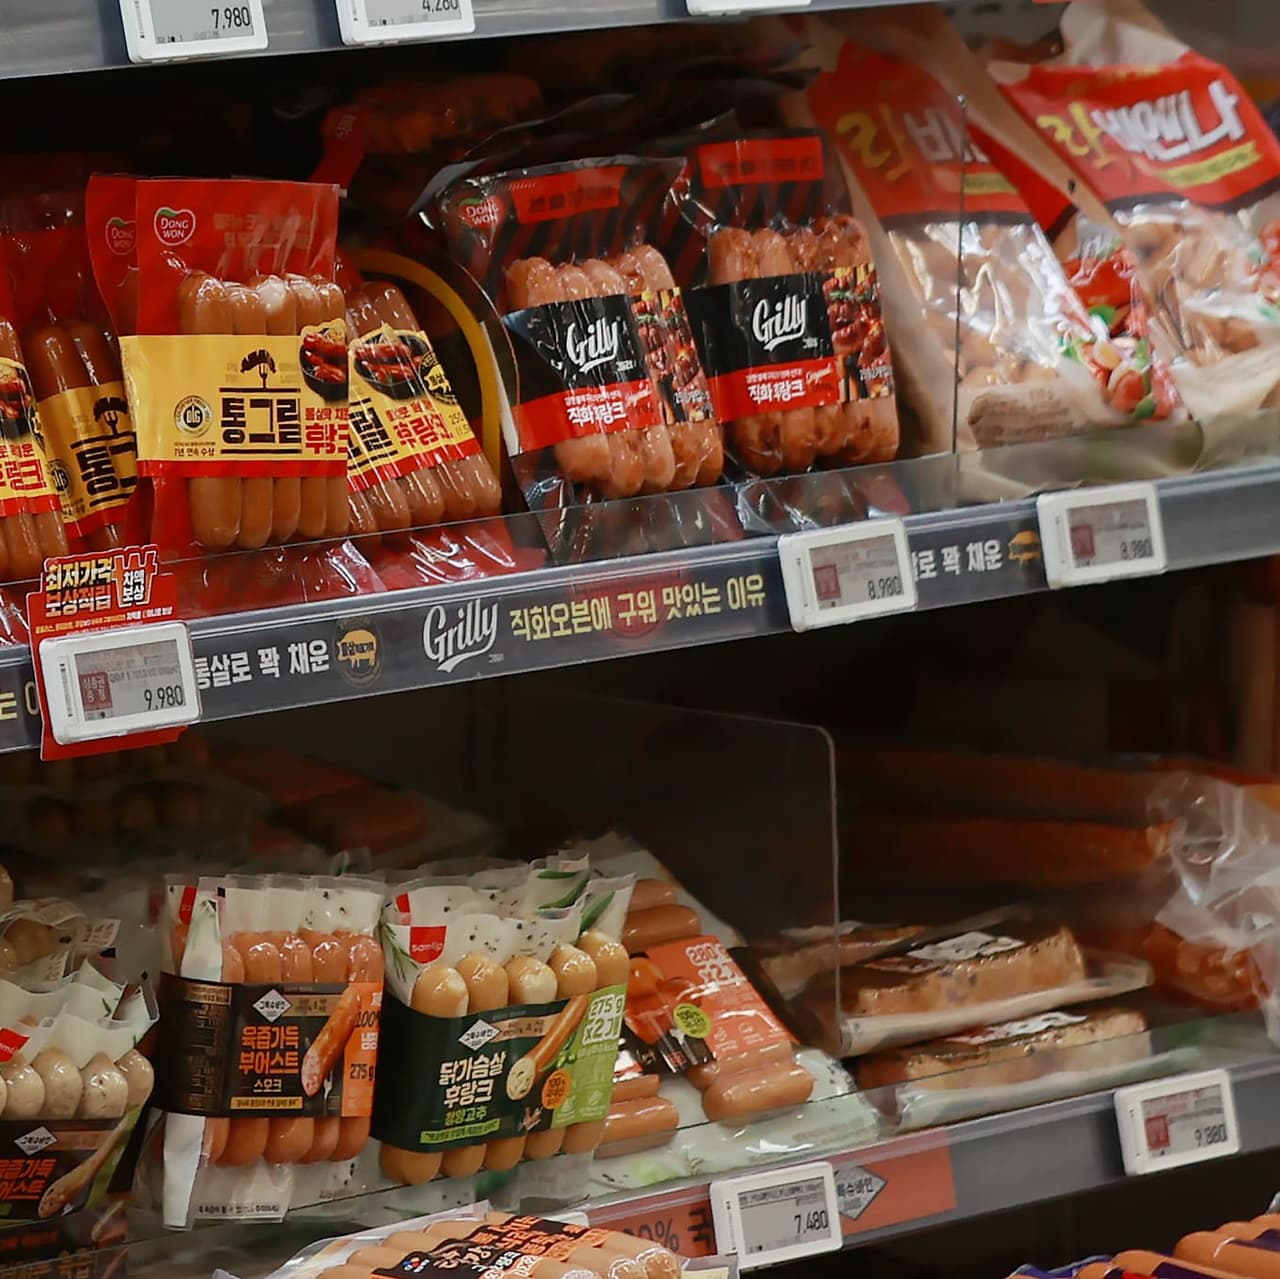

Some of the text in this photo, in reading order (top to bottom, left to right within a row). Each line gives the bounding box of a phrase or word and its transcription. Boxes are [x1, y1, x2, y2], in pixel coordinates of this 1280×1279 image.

[160, 216, 190, 230] DONG
[162, 228, 185, 240] WON
[752, 293, 808, 352] Grilly
[567, 316, 619, 373] Grilly
[220, 398, 303, 444] 통그릴
[967, 538, 1004, 573] 채운
[46, 558, 114, 591] 최저가격
[123, 569, 145, 586] 차액
[46, 585, 111, 617] 보상적립
[122, 586, 144, 602] 보상
[510, 573, 766, 642] 직화오븐에 구워 맛있는 이유
[422, 599, 499, 674] Grilly
[258, 645, 281, 680] 꽉
[287, 638, 330, 674] 채운
[241, 1024, 300, 1050] 육즙가득
[239, 1051, 299, 1075] 부어스트
[438, 1050, 507, 1086] 닭가슴살
[443, 1079, 494, 1109] 후랑크
